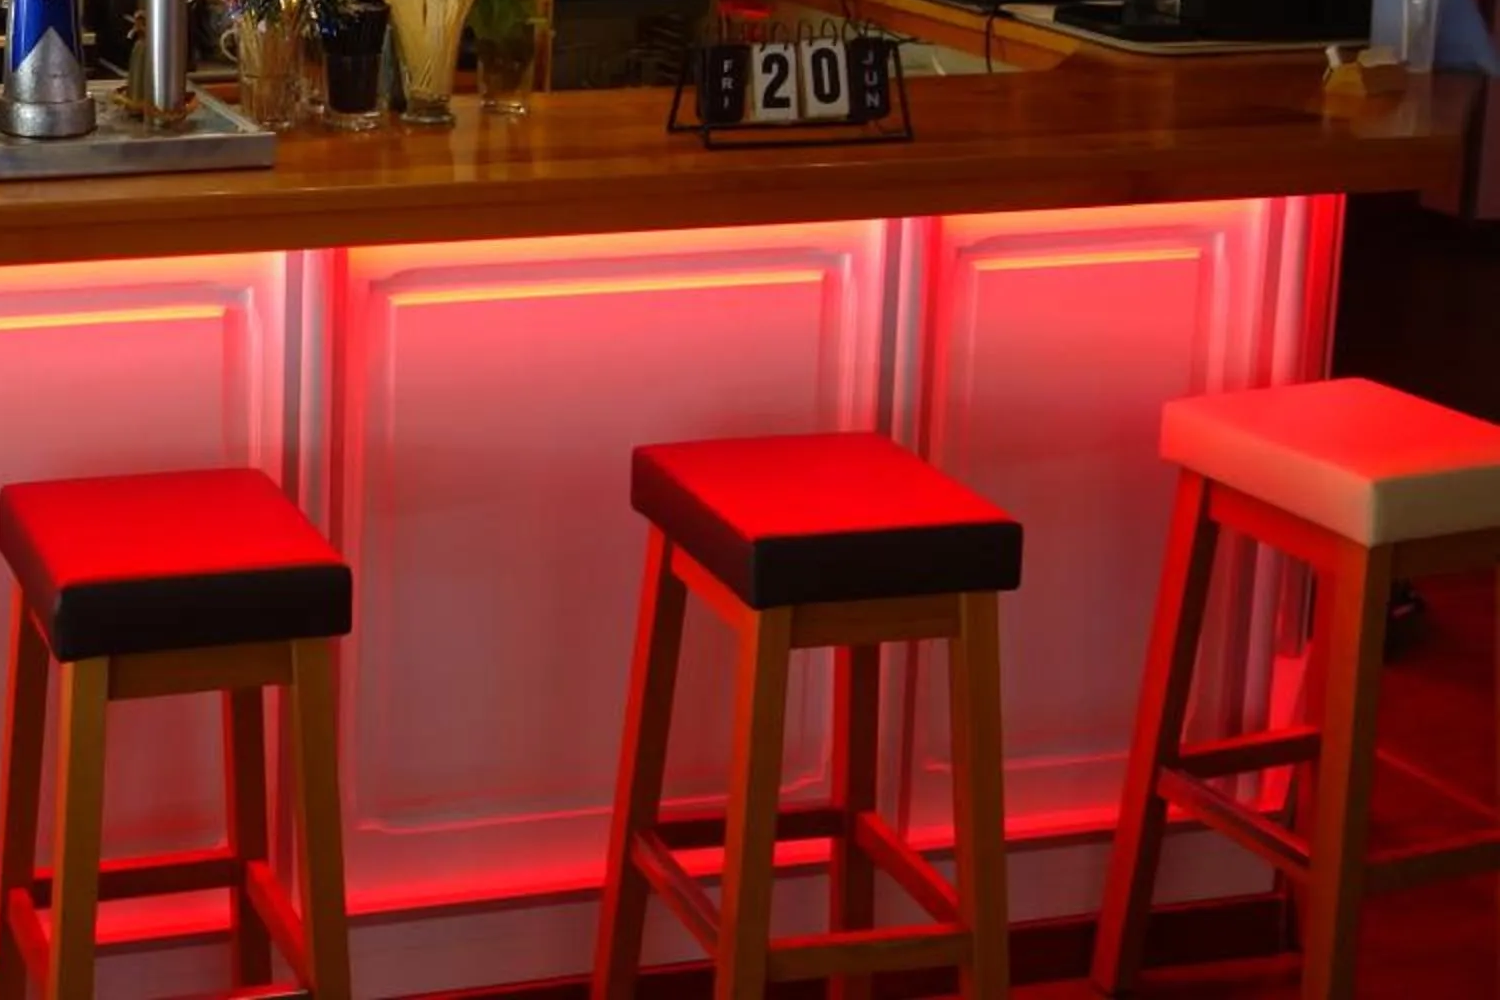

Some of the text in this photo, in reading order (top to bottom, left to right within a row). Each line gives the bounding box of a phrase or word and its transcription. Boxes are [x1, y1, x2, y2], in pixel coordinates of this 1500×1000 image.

[721, 47, 881, 109] FRI 20 JUN
